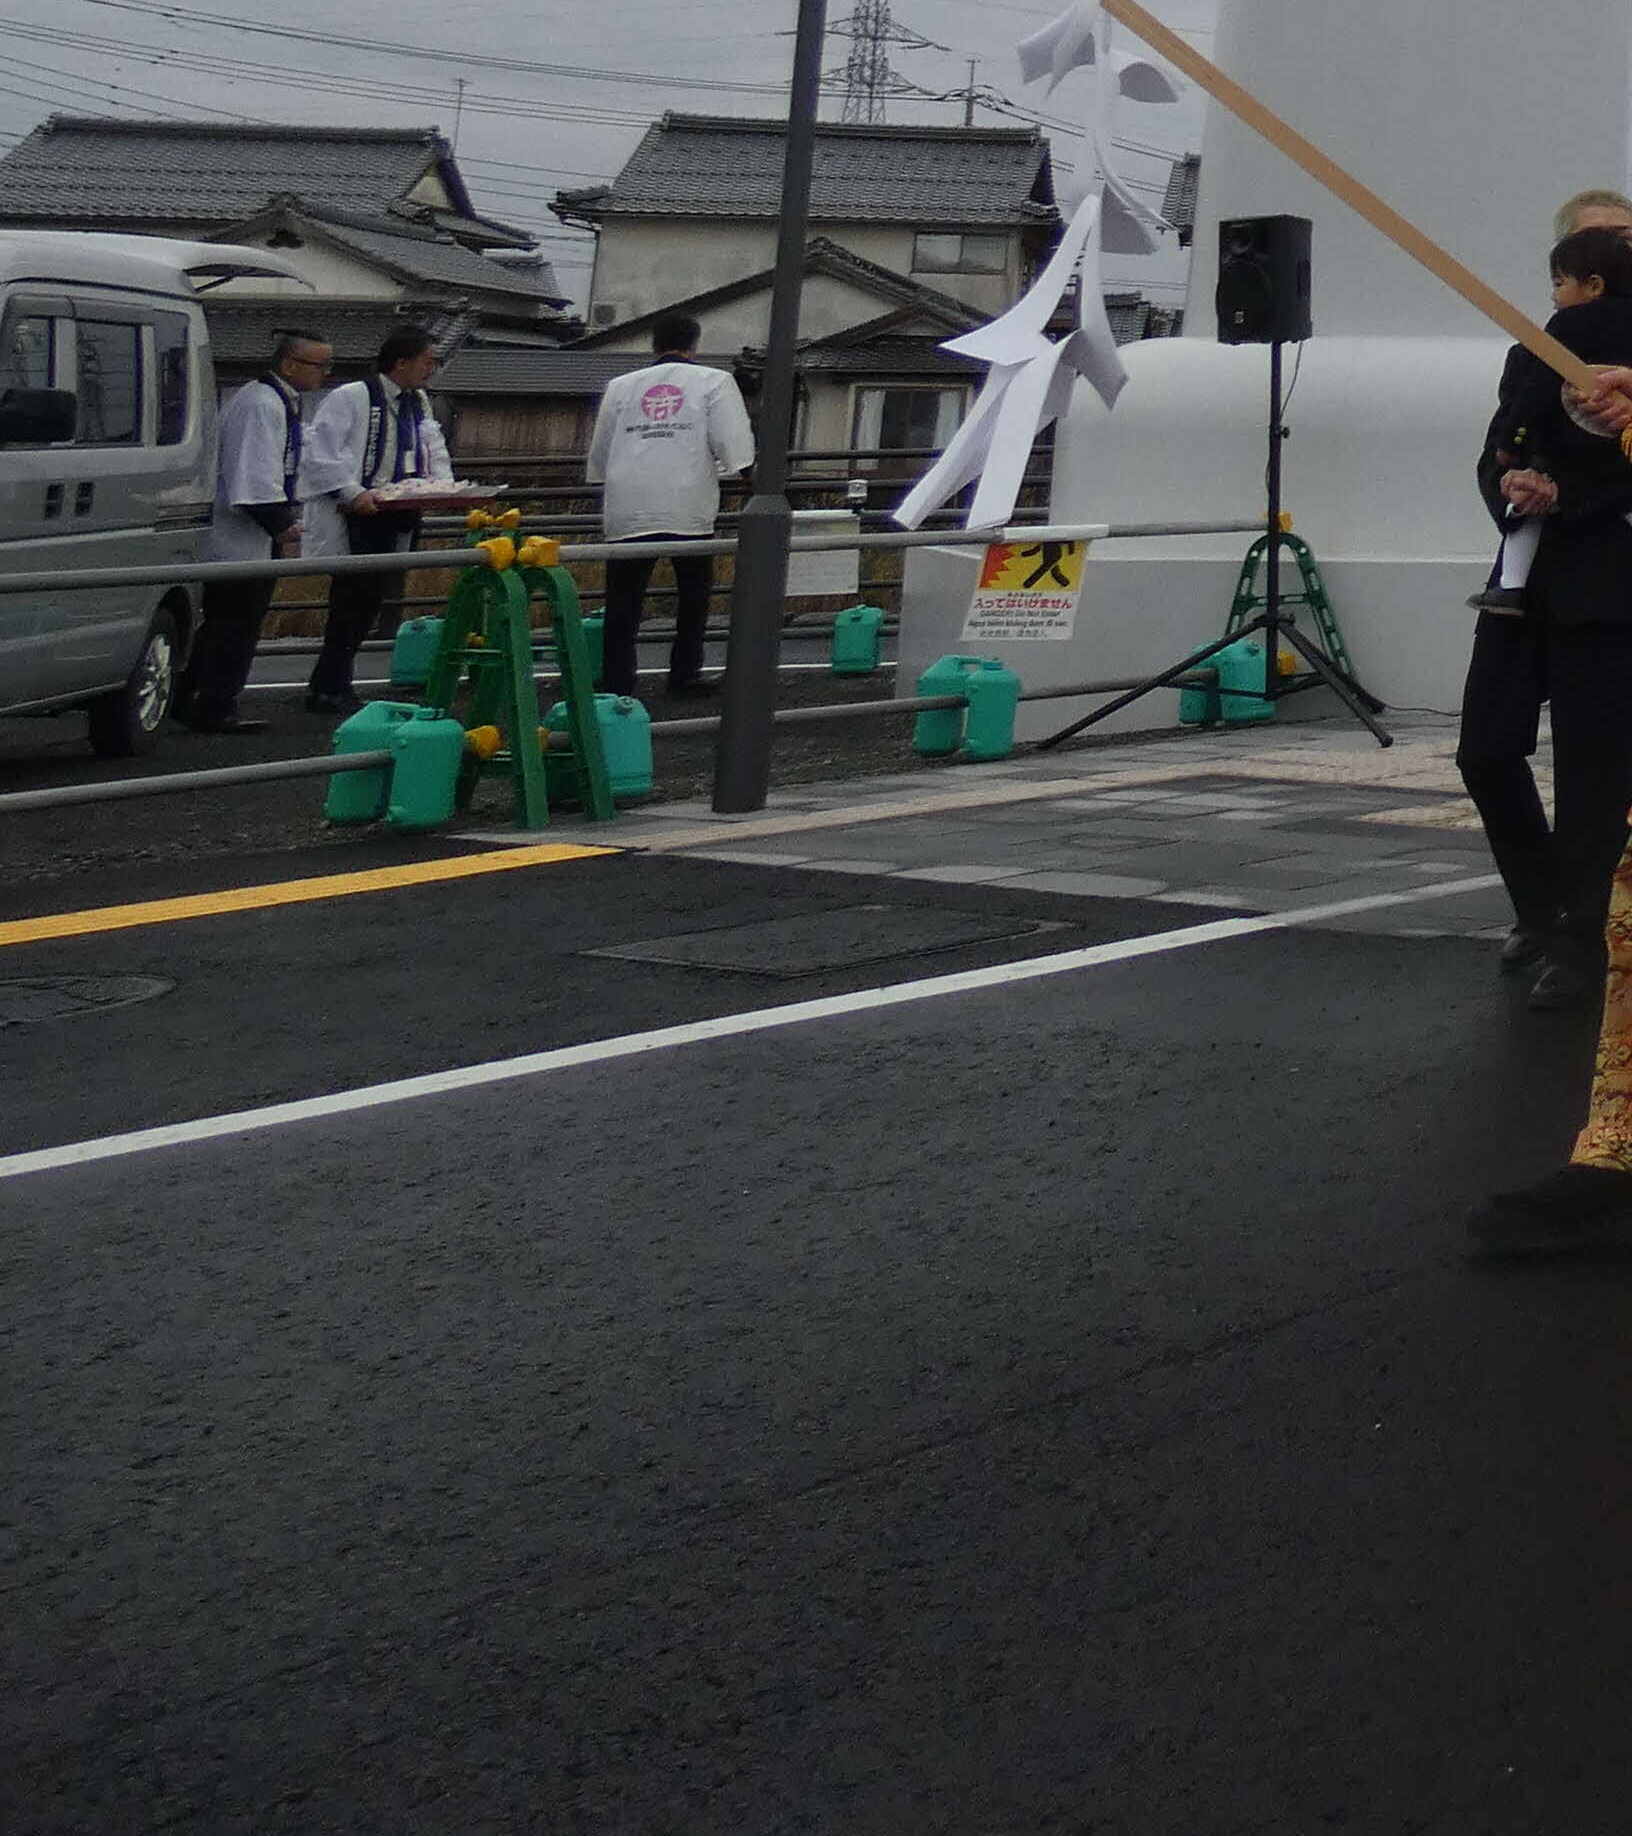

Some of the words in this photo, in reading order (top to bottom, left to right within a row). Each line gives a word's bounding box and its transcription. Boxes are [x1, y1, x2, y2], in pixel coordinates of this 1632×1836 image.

[974, 597, 1073, 610] 入ってはいけません
